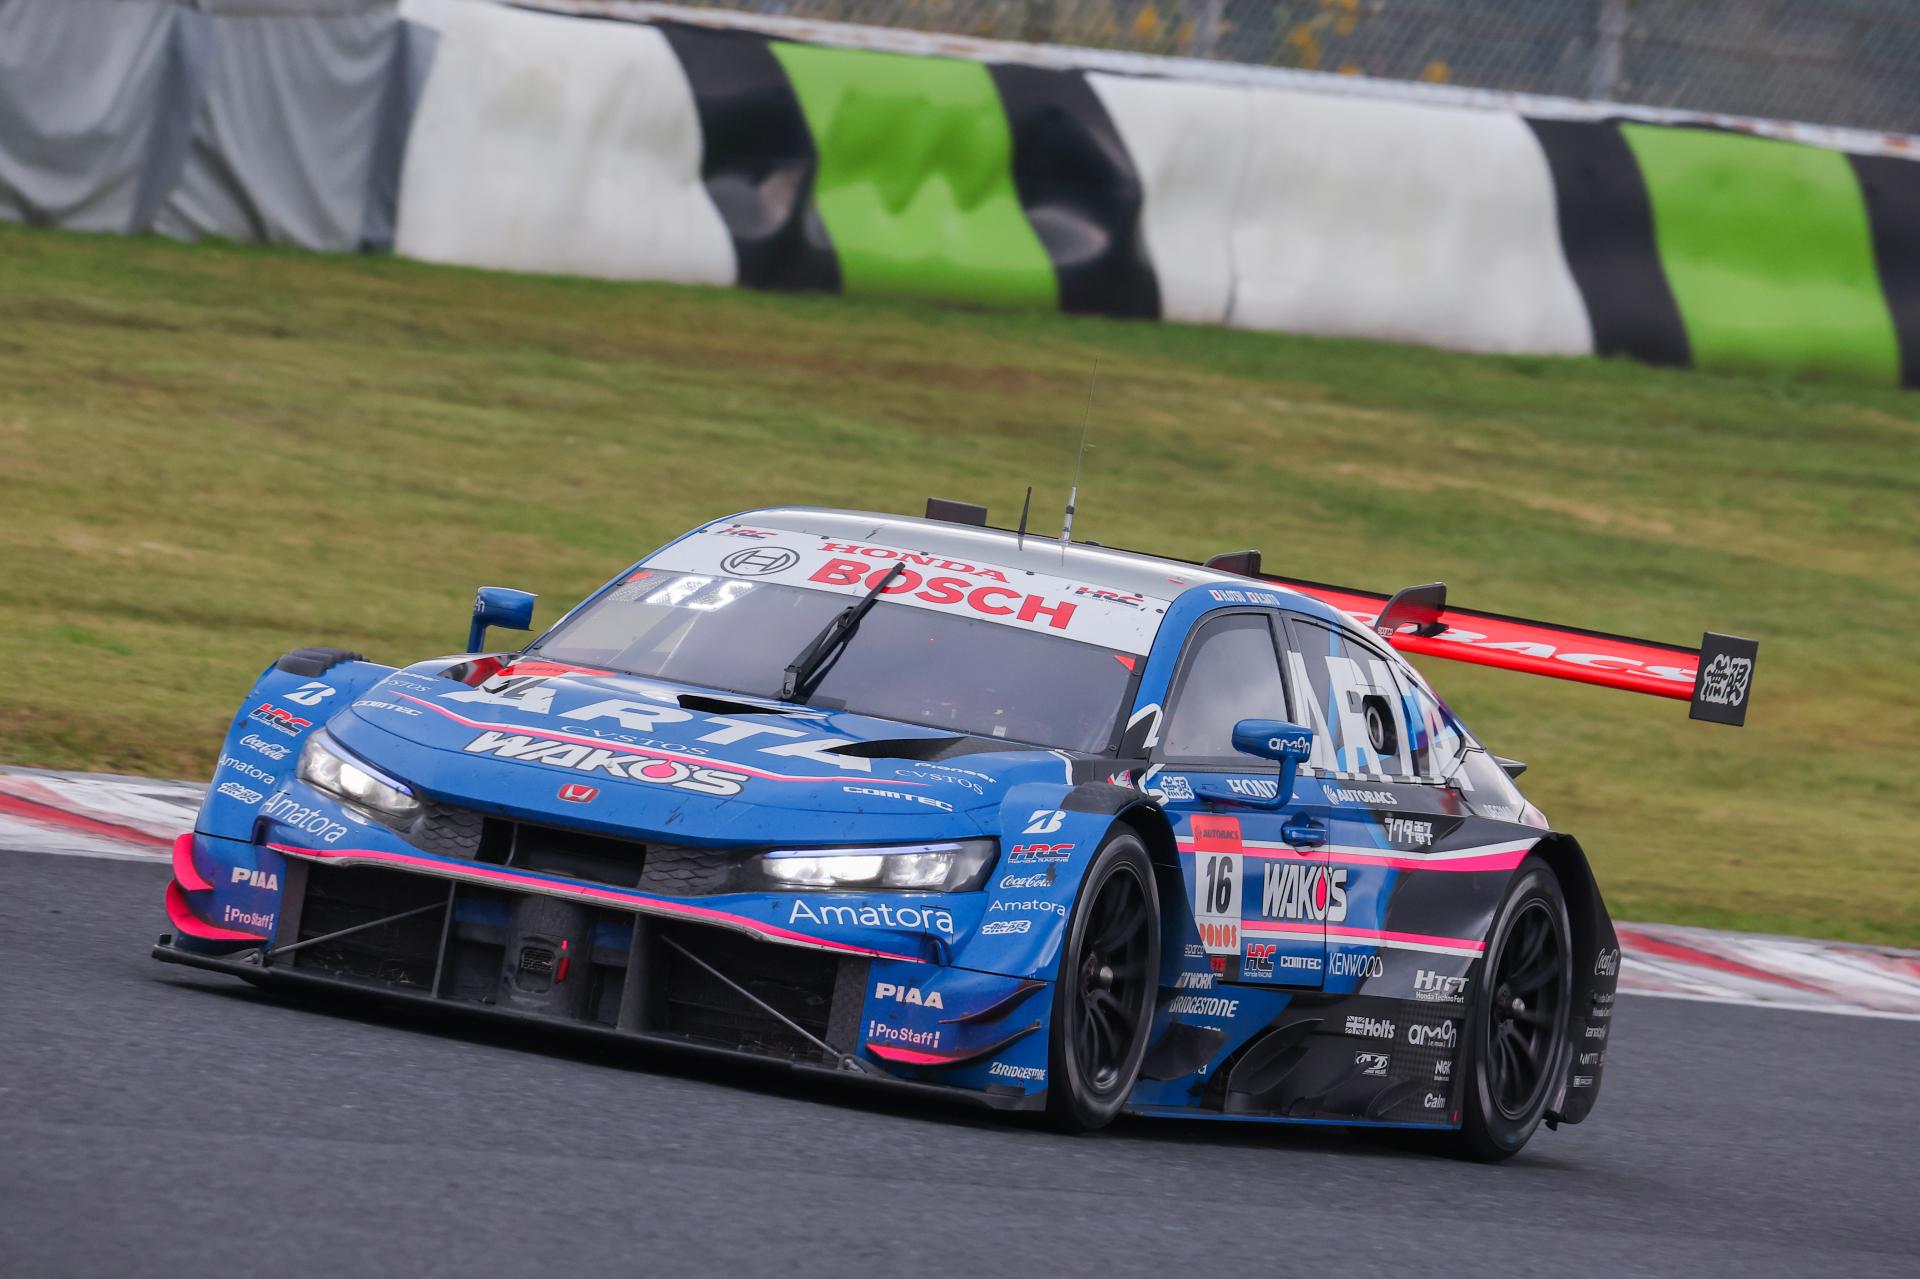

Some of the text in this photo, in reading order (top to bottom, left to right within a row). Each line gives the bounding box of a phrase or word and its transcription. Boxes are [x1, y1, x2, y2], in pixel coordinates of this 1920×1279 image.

[817, 542, 1011, 584] HONDA
[807, 558, 1077, 629] BOSCH
[218, 753, 276, 785] Amatora
[843, 786, 953, 812] COMTEC
[1336, 788, 1398, 806] AUTOBACS
[259, 789, 349, 844] Amatora
[231, 867, 278, 891] PIAA
[1206, 855, 1233, 914] 16
[788, 899, 954, 935] Amatora
[989, 899, 1067, 917] Amatora
[1280, 955, 1322, 970] COMTEC
[1328, 952, 1384, 978] KENWOOD
[875, 981, 944, 1010] PIAA
[1168, 995, 1240, 1018] BRIDGESTONE
[1364, 1017, 1396, 1040] Holts
[988, 1061, 1046, 1081] BRIDGESTONE
